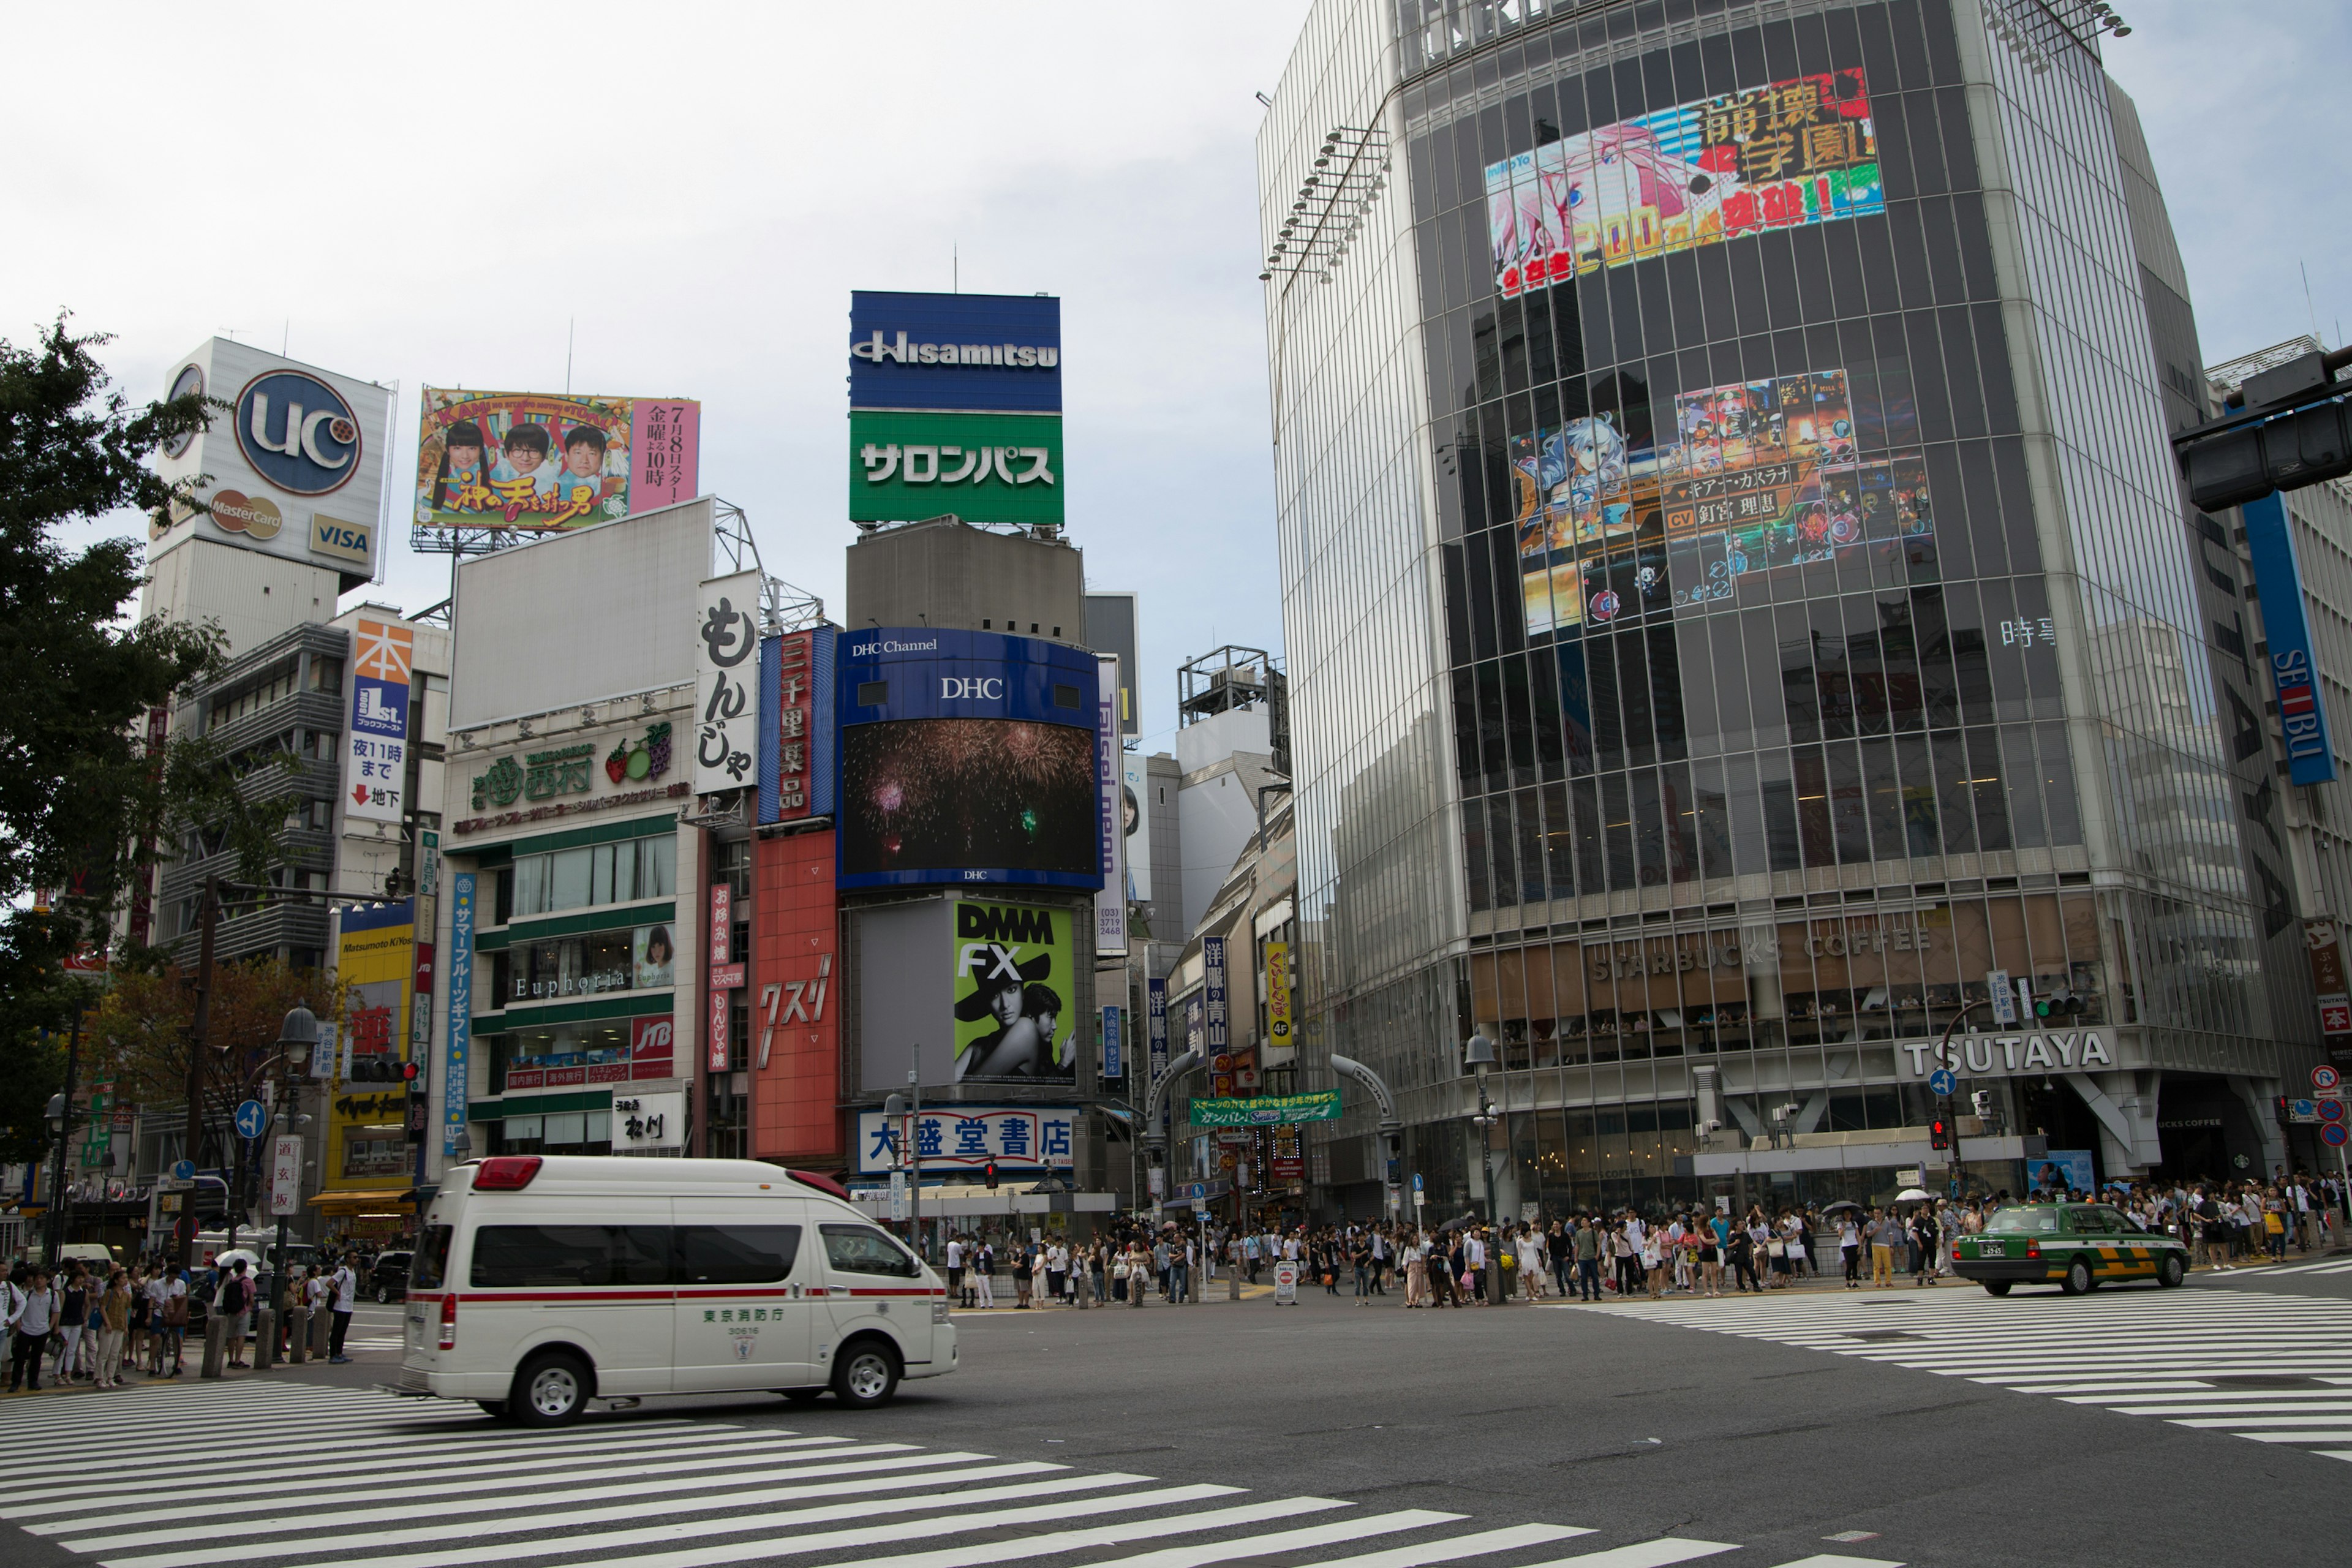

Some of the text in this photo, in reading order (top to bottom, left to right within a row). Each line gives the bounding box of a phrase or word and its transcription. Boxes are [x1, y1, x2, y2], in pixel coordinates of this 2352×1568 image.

[851, 330, 1058, 367] Hisamitsu
[437, 401, 491, 426] KAMI
[646, 405, 666, 487] 金曜よる10時
[861, 443, 1054, 484] サロンパス
[1689, 467, 1790, 497] キアナ・カスラナ
[213, 500, 281, 528] MasterCard
[1672, 513, 1691, 526] CV
[318, 525, 368, 552] VISA
[853, 638, 938, 657] DHC Channel
[698, 597, 755, 782] もんじゃ
[941, 677, 1003, 700] DHC
[358, 718, 402, 732] ブックファースト
[779, 637, 807, 810] 三千里薬品
[353, 739, 402, 763] 夜11時
[361, 760, 391, 780] まで
[525, 757, 593, 801] 西村
[372, 787, 400, 808] 地下
[964, 870, 987, 880] DHC
[714, 889, 728, 961] お好み焼
[957, 903, 1055, 945] DMM
[1100, 918, 1120, 927] 3719
[1101, 908, 1118, 917] (03)
[343, 941, 388, 953] Matsumoto
[1593, 925, 1931, 981] STARBUCKS COFFEE
[957, 943, 1023, 981] FX
[453, 908, 471, 1048] サマーフルーツギフト
[515, 968, 625, 998] Euphoria
[1270, 952, 1289, 1017] くいしんぼ
[1206, 942, 1226, 1045] 洋服の青山
[1997, 974, 2012, 1019] 渋谷駅前
[712, 993, 726, 1068] もんじゃ焼
[1274, 1023, 1287, 1034] 4F
[2326, 1010, 2345, 1028] 本
[321, 1026, 334, 1074] 渋谷駅前
[635, 1020, 673, 1053] JTB
[1106, 1009, 1117, 1073] 大盛堂商事ビル
[1151, 990, 1167, 1083] 洋服の青
[1903, 1031, 2111, 1076] TSUTAYA
[509, 1074, 542, 1086] 国内旅行
[549, 1071, 582, 1084] 海外旅行
[614, 1099, 640, 1112] うなぎ
[1251, 1112, 1280, 1122] Swallows
[625, 1114, 664, 1140] 松川
[2185, 1118, 2222, 1128] COFFEE
[870, 1117, 1071, 1160] 大盛堂書店
[275, 1143, 292, 1208] 道玄坂
[291, 1142, 300, 1182] Dougen-zaka
[1605, 1167, 1645, 1178] COFFEE
[704, 1308, 784, 1324] 東京消防庁
[728, 1327, 760, 1335] 30616
